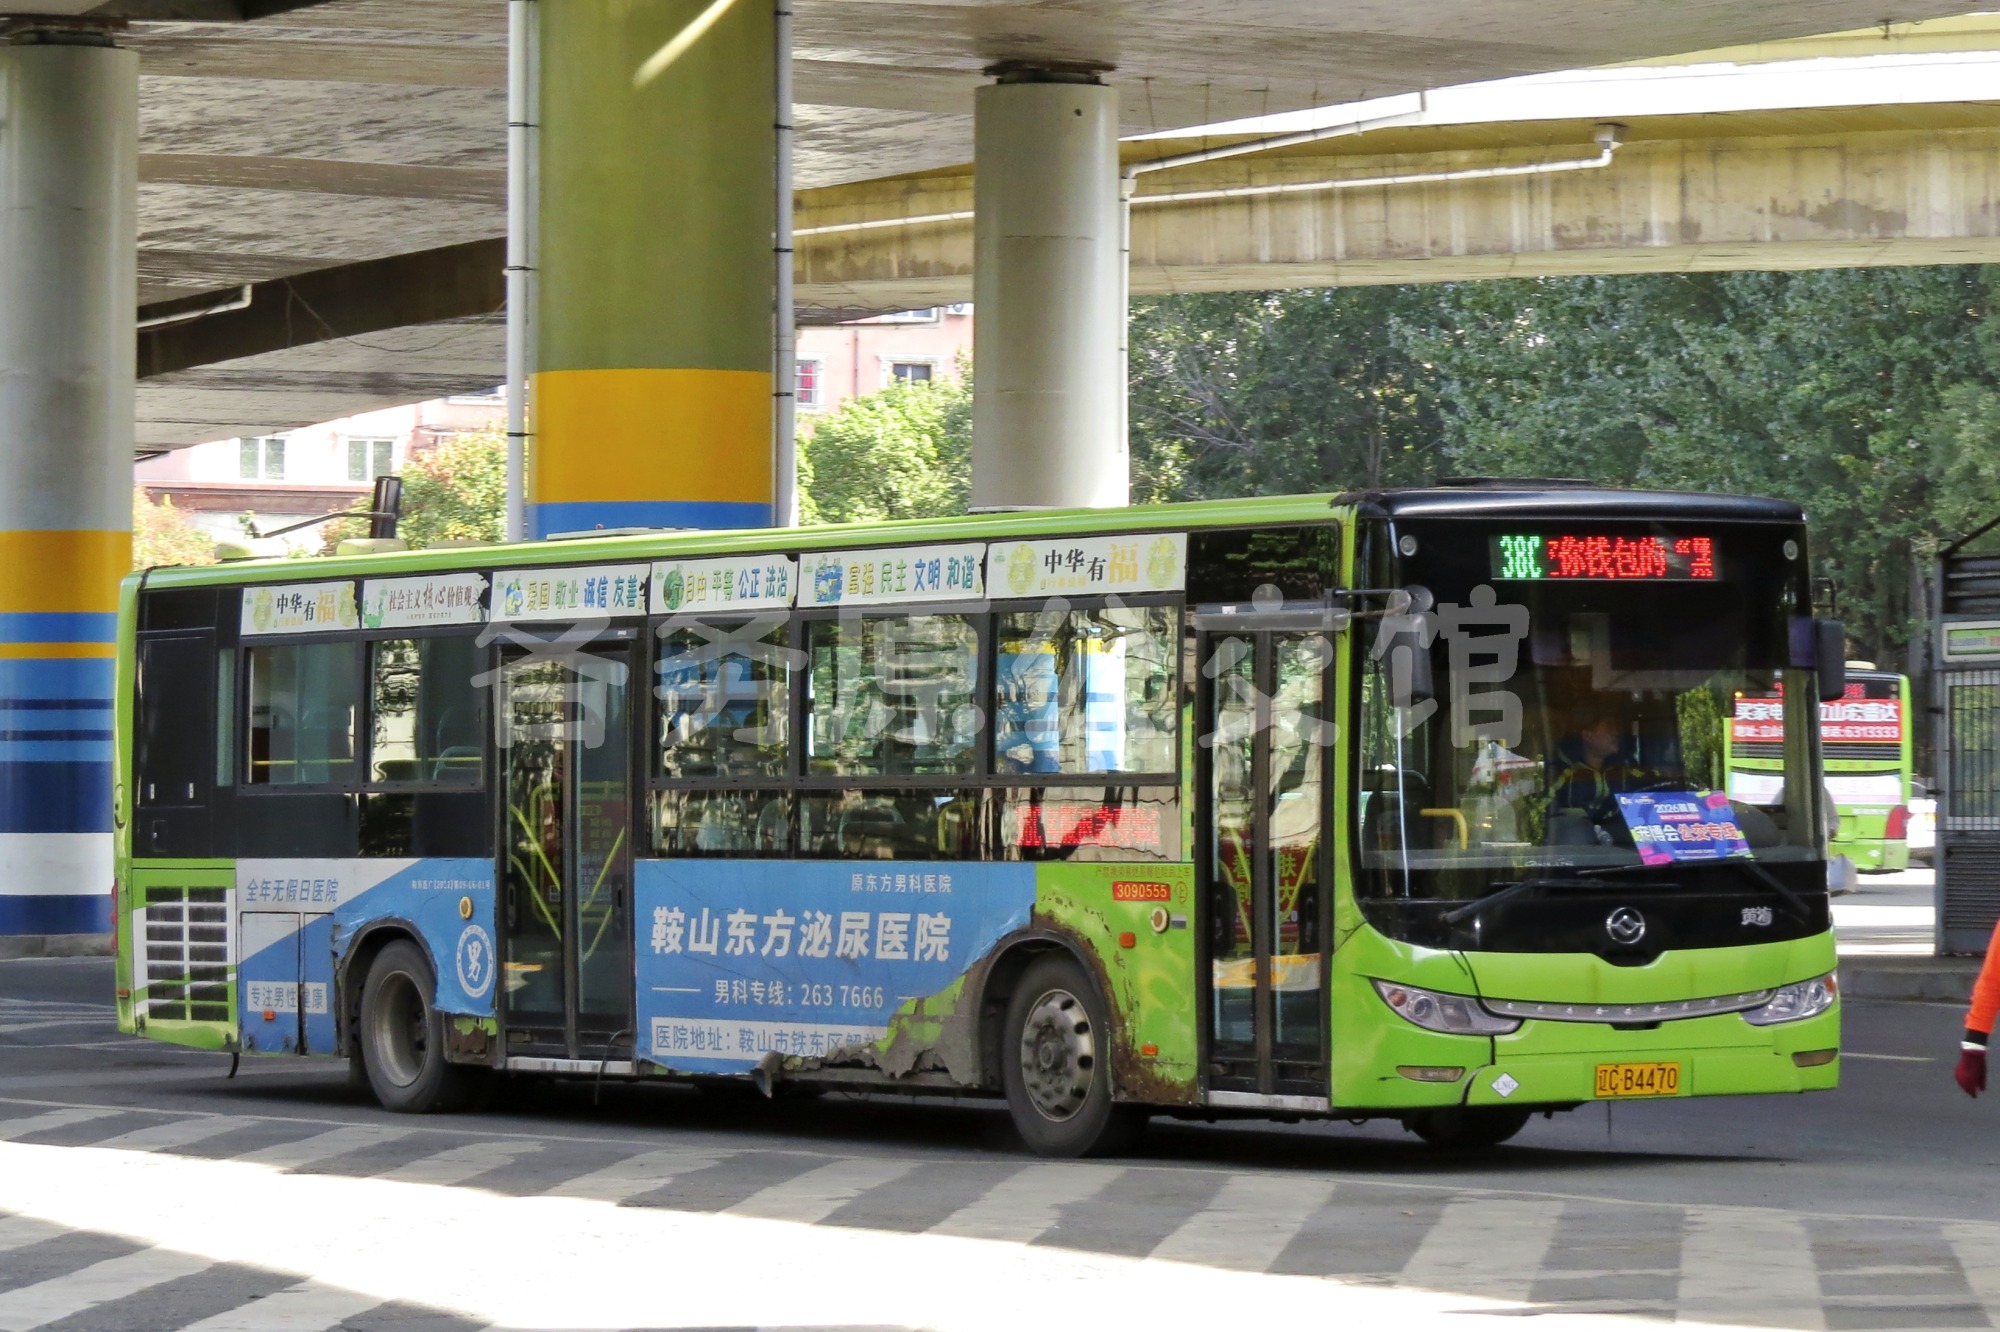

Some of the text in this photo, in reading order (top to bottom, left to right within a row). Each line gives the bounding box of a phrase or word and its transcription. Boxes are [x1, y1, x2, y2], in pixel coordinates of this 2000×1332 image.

[849, 555, 974, 595] 富强 民主 文明 和谐
[1044, 543, 1138, 583] 中华有福
[389, 583, 472, 611] 社会主义核心价值观
[527, 574, 637, 612] 爱国 敬业 诚信 友善
[686, 565, 787, 603] 自由 平等 公正 法治
[277, 589, 336, 623] 中华有福
[246, 878, 339, 902] 全年无假日医院
[851, 873, 952, 893] 原东方男科医院
[1117, 884, 1167, 898] 3090555
[651, 906, 951, 961] 鞍山东方泌尿医院
[840, 985, 884, 1009] 7666
[1496, 1080, 1514, 1091] LNG
